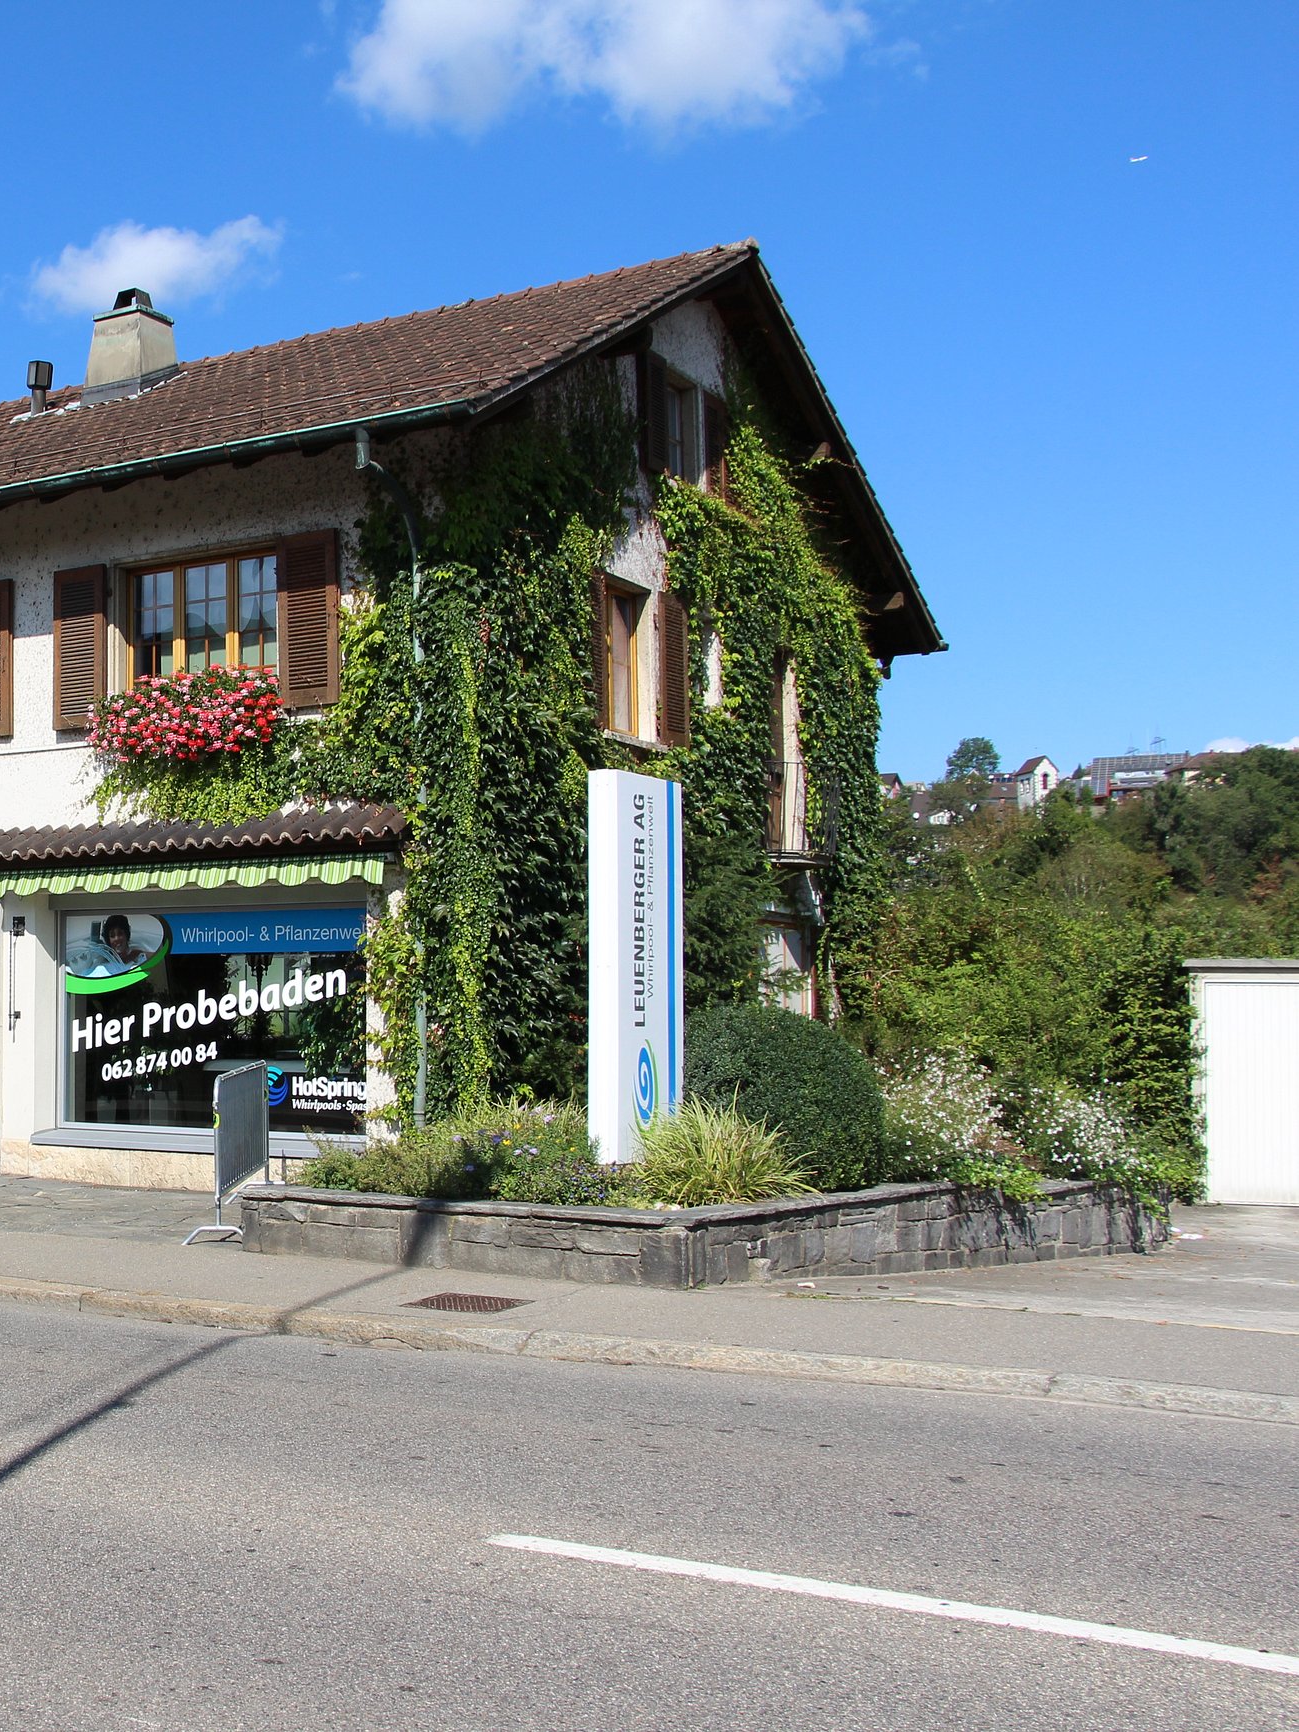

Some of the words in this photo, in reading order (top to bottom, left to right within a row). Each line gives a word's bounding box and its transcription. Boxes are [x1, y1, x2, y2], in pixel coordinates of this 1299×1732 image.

[633, 793, 645, 831] AG
[646, 795, 654, 895] Pflanzenwelt
[646, 901, 654, 912] &
[181, 926, 255, 945] Whirlpool-
[259, 926, 270, 942] &
[274, 924, 366, 941] Pflanzenwel
[633, 837, 646, 1027] LEUENBERGER
[646, 917, 654, 999] Whirlpool-
[71, 1013, 135, 1053] Hier
[142, 968, 347, 1038] Probebaden
[101, 1059, 132, 1082] 062
[135, 1051, 168, 1076] 874
[170, 1045, 193, 1069] 00
[195, 1041, 218, 1063] 84
[292, 1076, 367, 1100] HotSpring
